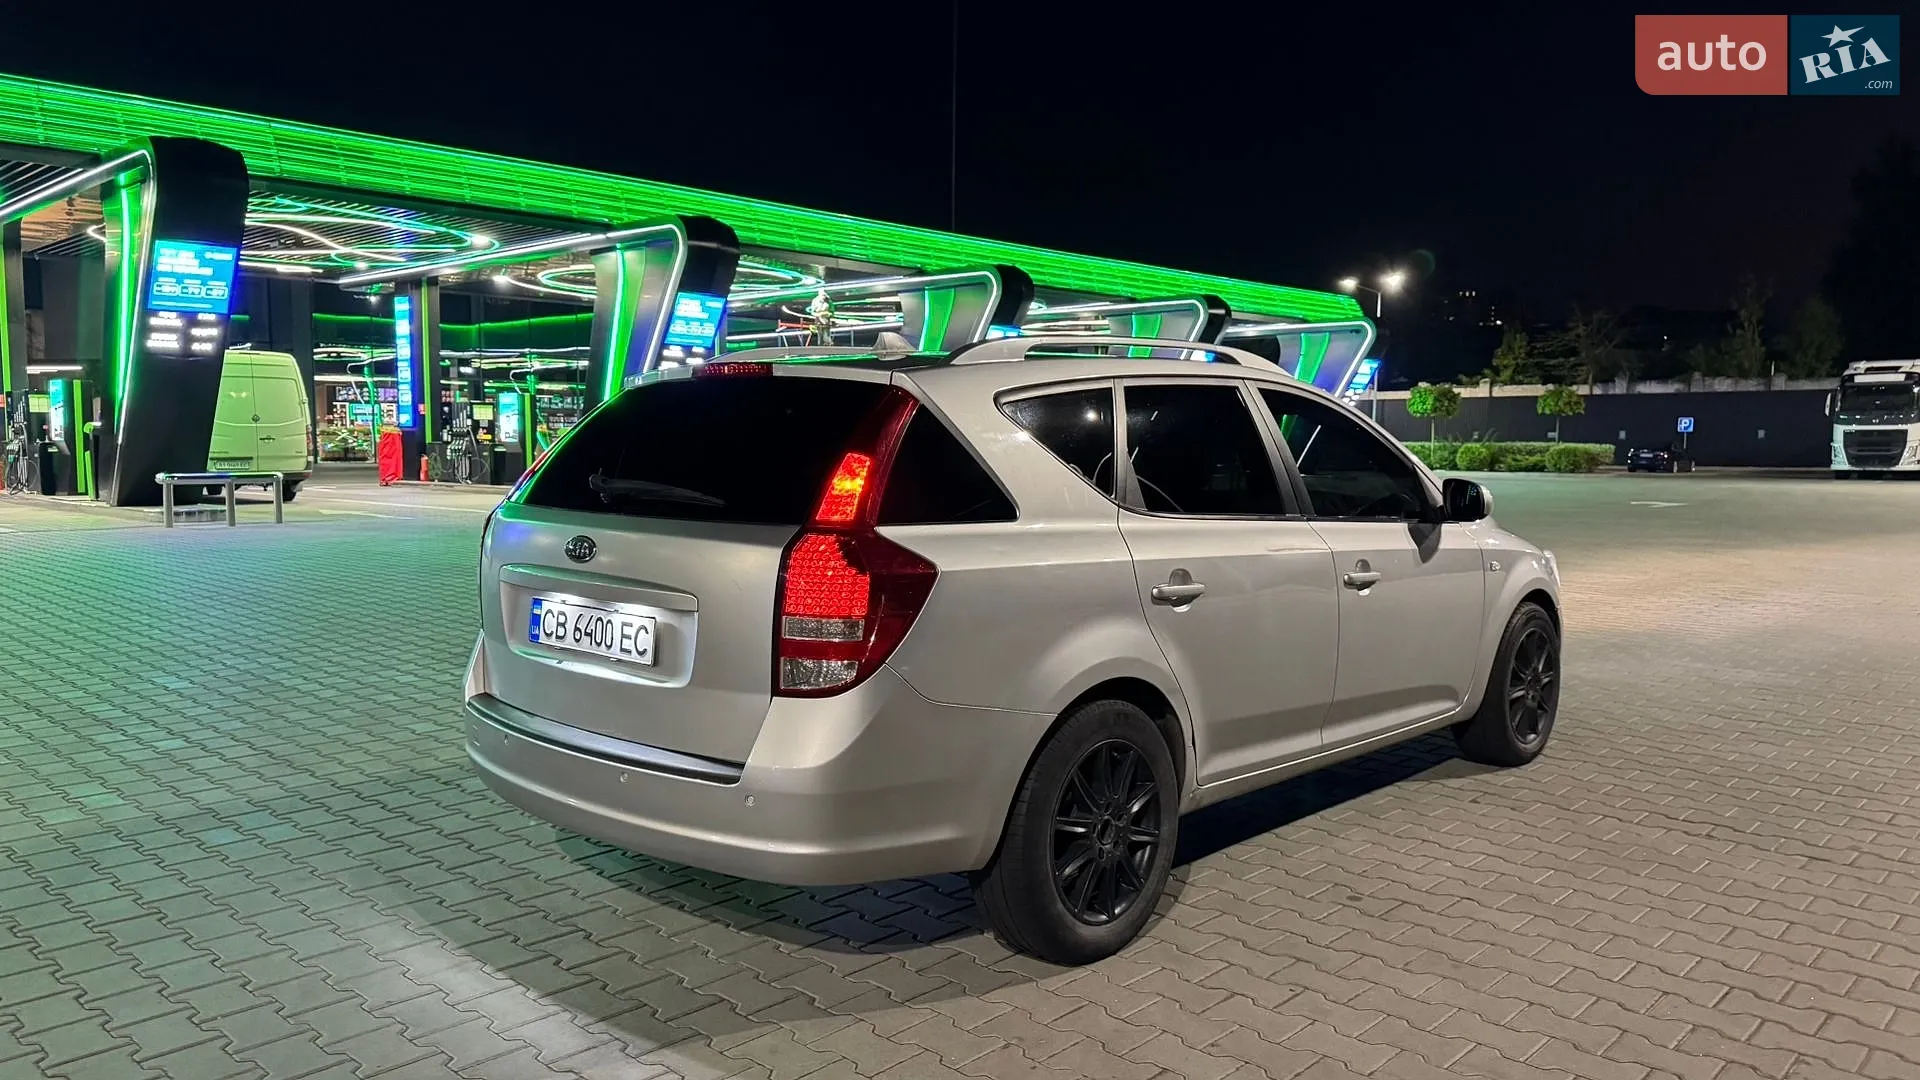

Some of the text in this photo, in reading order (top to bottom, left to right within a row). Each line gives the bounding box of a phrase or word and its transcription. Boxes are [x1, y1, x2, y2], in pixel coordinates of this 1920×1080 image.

[531, 624, 541, 635] UA
[542, 608, 650, 657] CB 6400 EC
